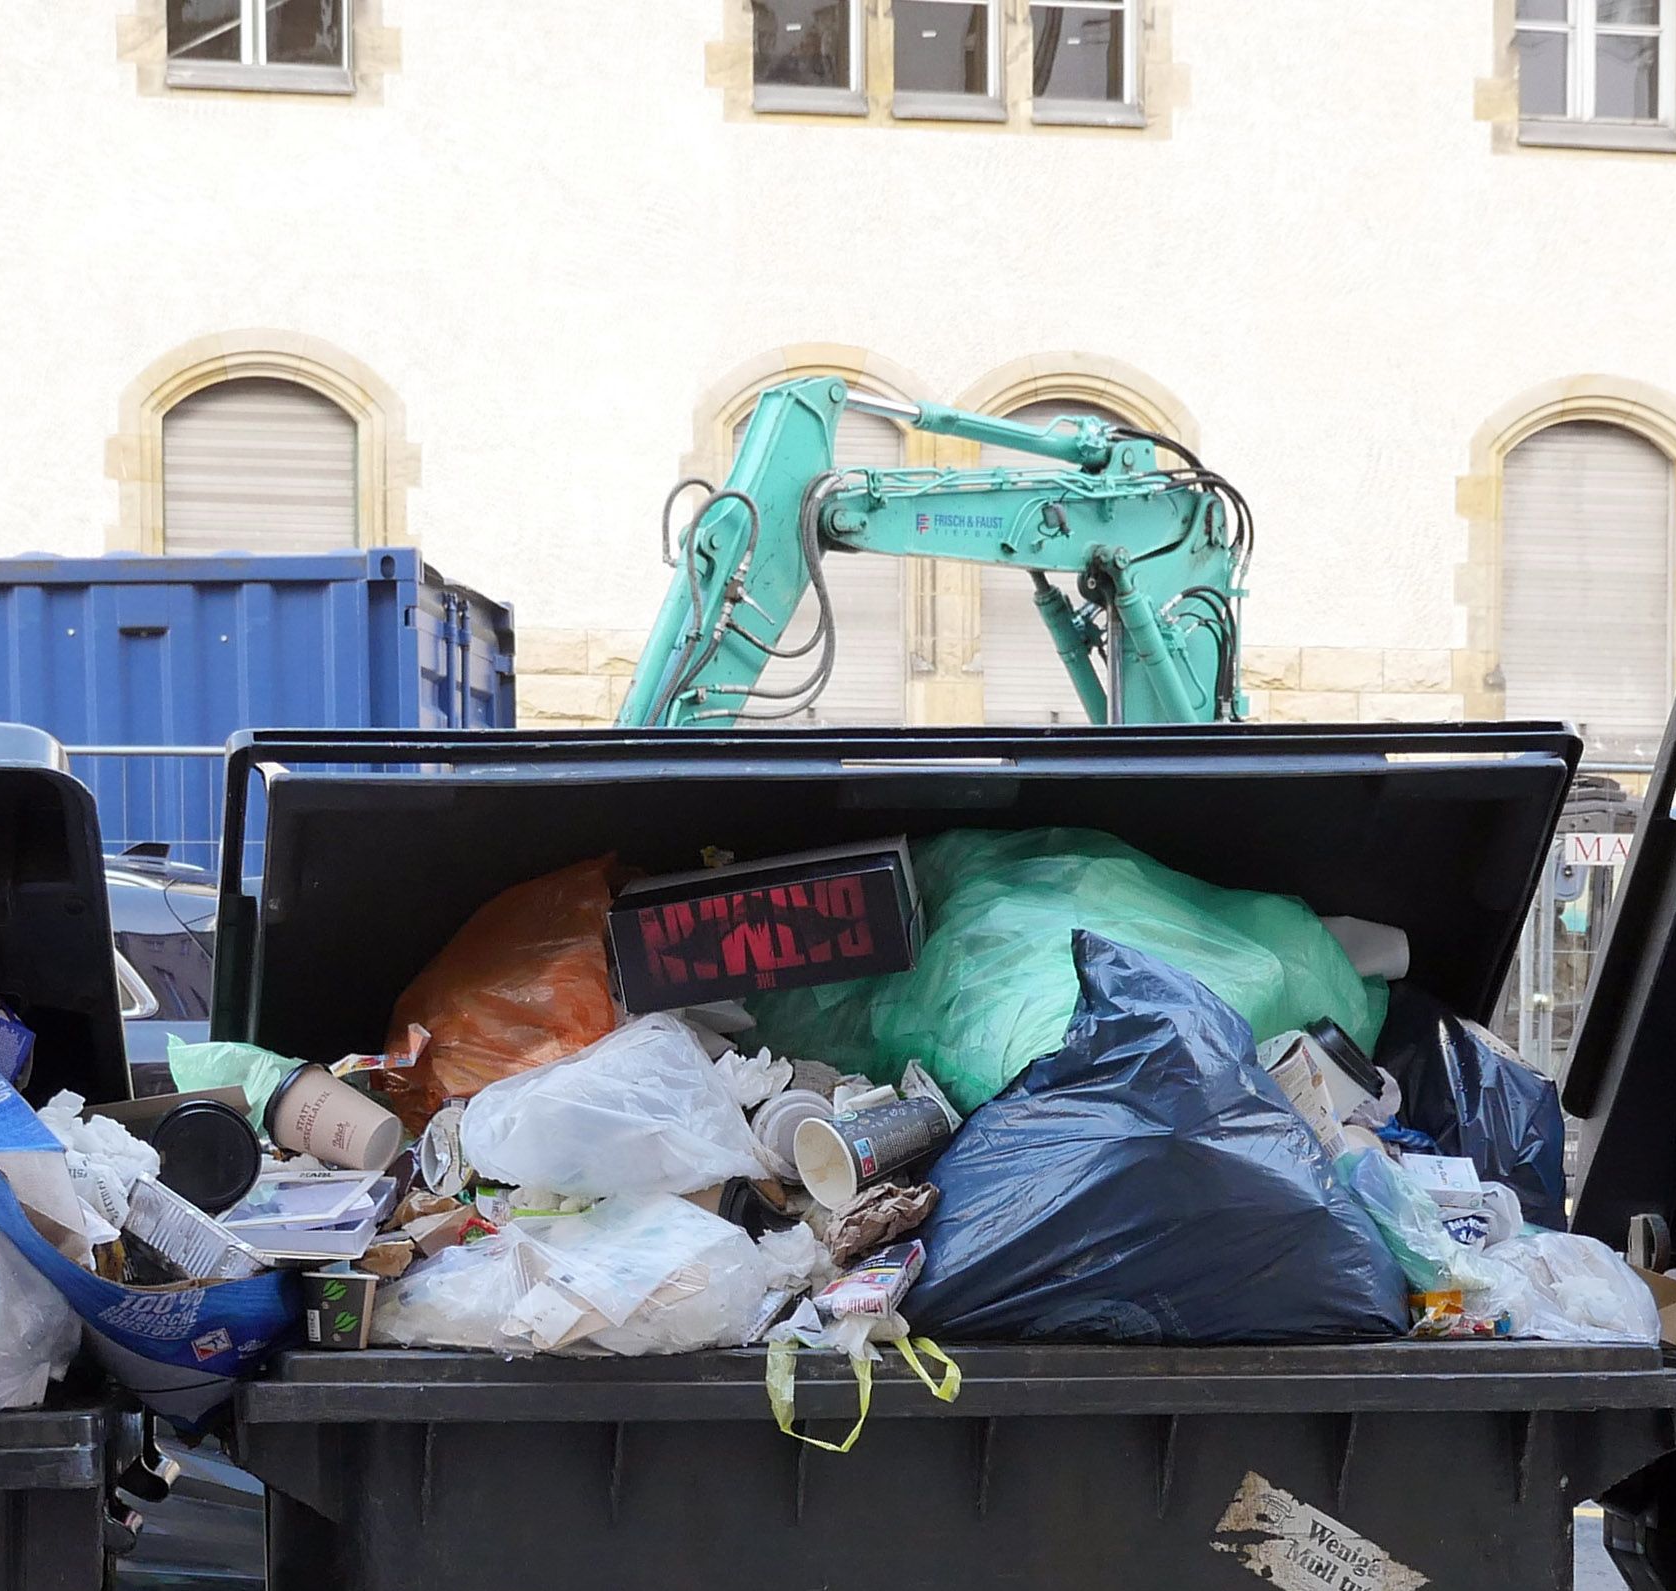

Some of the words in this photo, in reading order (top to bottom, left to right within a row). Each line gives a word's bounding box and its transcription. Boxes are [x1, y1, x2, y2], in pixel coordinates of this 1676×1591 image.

[934, 514, 965, 528] FRISCH
[967, 515, 973, 528] &
[975, 515, 1004, 529] FAUST
[120, 1289, 206, 1315] 100%
[1308, 1518, 1382, 1578] Wenige
